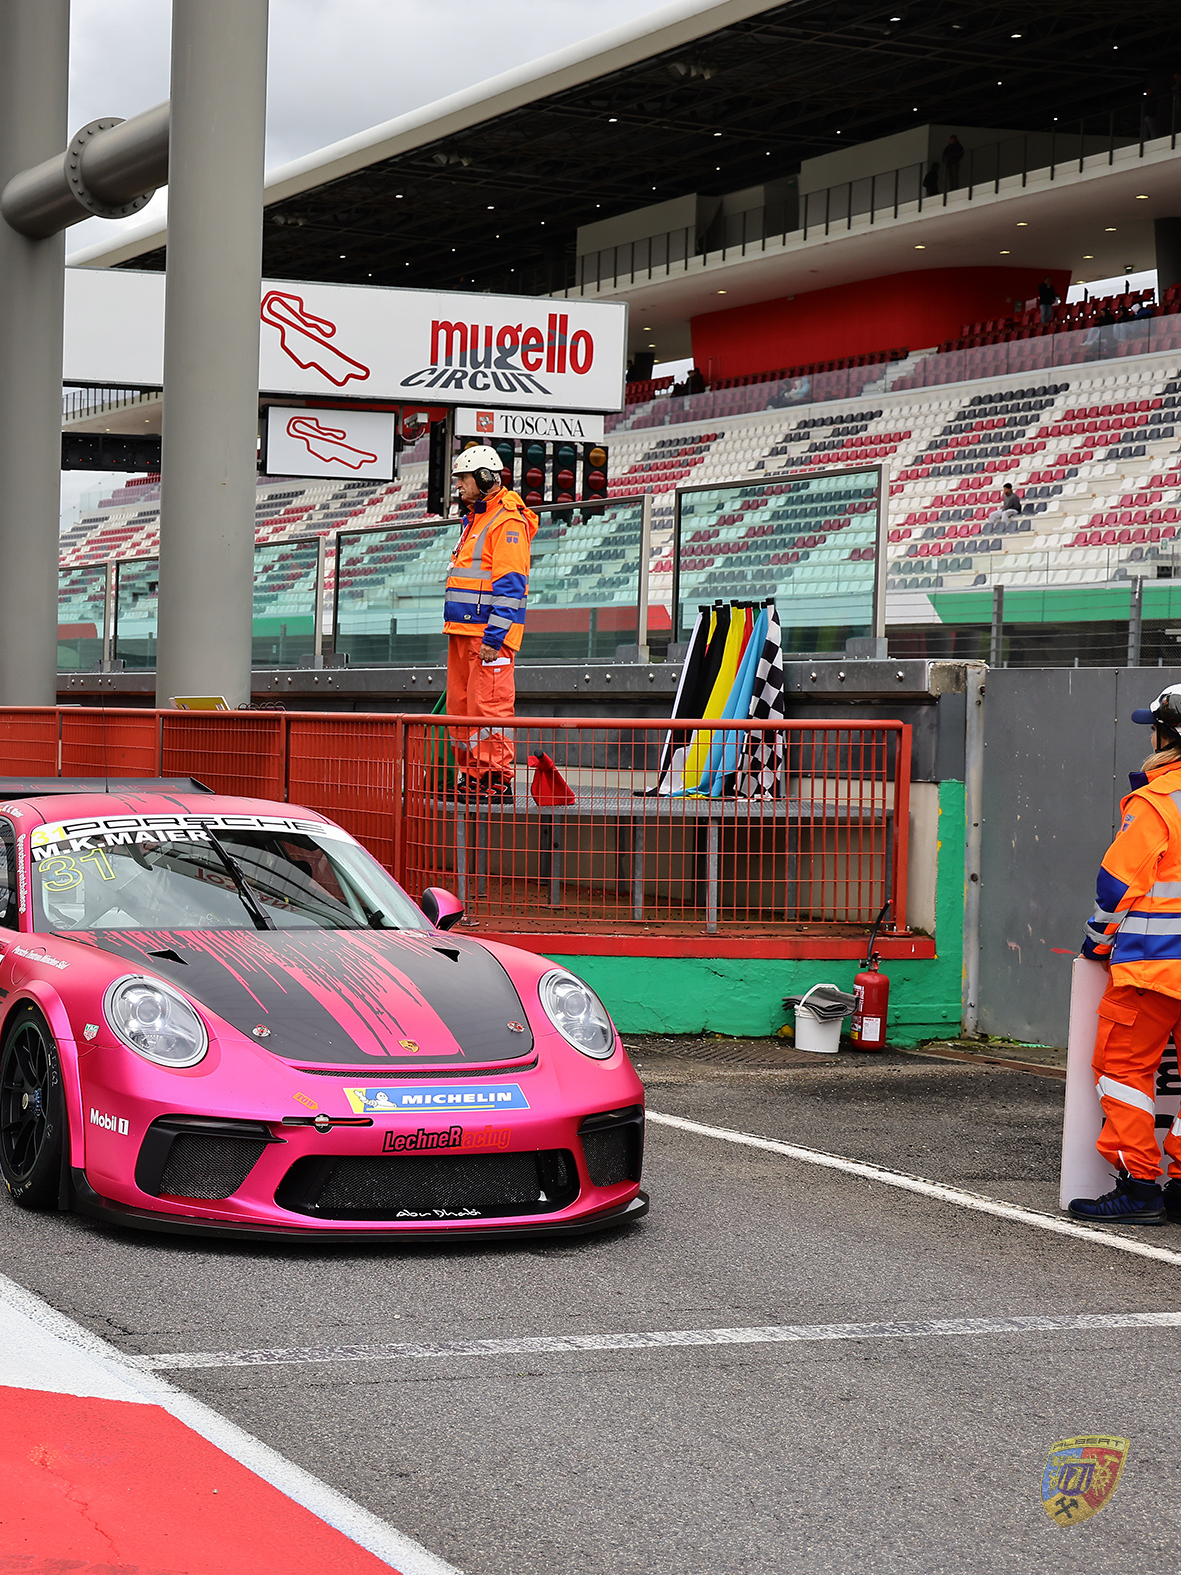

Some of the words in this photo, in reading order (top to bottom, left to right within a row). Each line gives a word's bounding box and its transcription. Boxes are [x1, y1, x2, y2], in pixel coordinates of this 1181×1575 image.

[430, 313, 594, 375] mugello
[400, 367, 553, 395] CIRCUIT
[500, 414, 585, 438] TOSCANA
[30, 826, 67, 846] 31
[62, 816, 328, 836] PORSCHE
[32, 829, 213, 862] M.K.MAIER
[38, 848, 116, 892] 31
[401, 1091, 512, 1105] MICHELIN
[90, 1107, 117, 1132] Mobil
[395, 1208, 431, 1218] Abu
[432, 1207, 481, 1218] Dhabi
